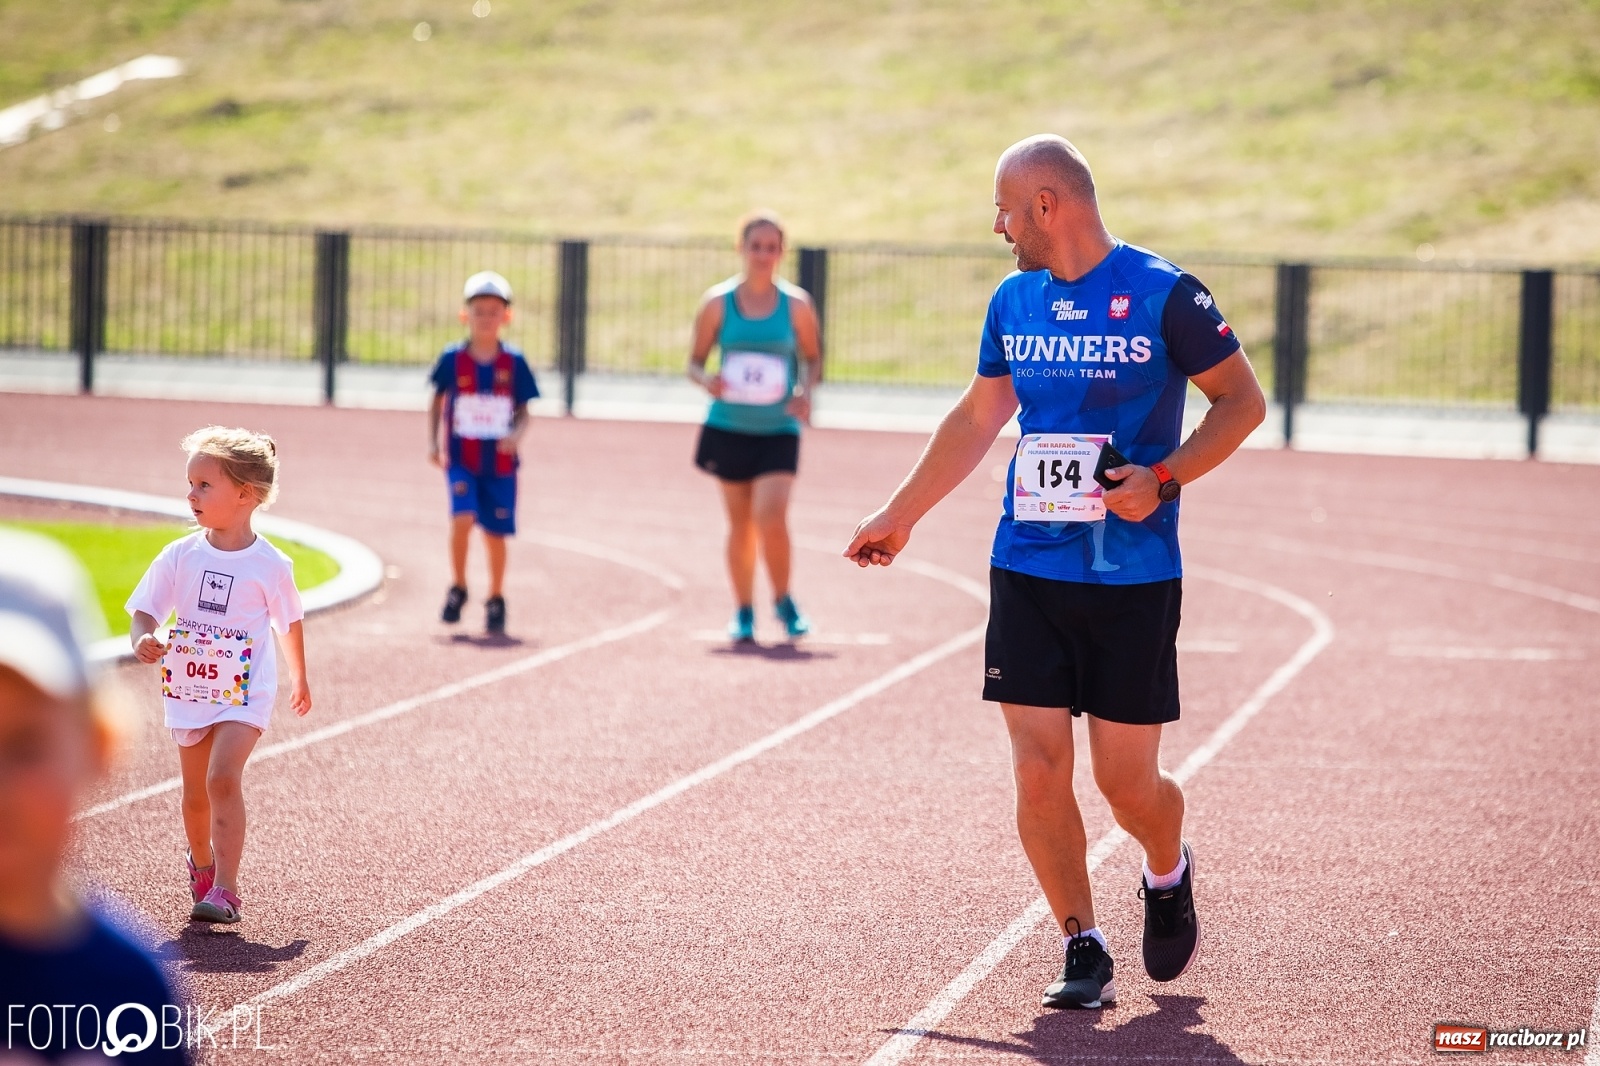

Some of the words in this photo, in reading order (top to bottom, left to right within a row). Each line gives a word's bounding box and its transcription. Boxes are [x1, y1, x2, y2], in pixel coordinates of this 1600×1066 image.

[1002, 334, 1152, 363] RUNNERS
[1080, 369, 1117, 379] TEAM
[1037, 459, 1082, 489] 154
[176, 645, 204, 656] KIDS
[208, 649, 233, 658] RUN
[186, 661, 218, 680] 045
